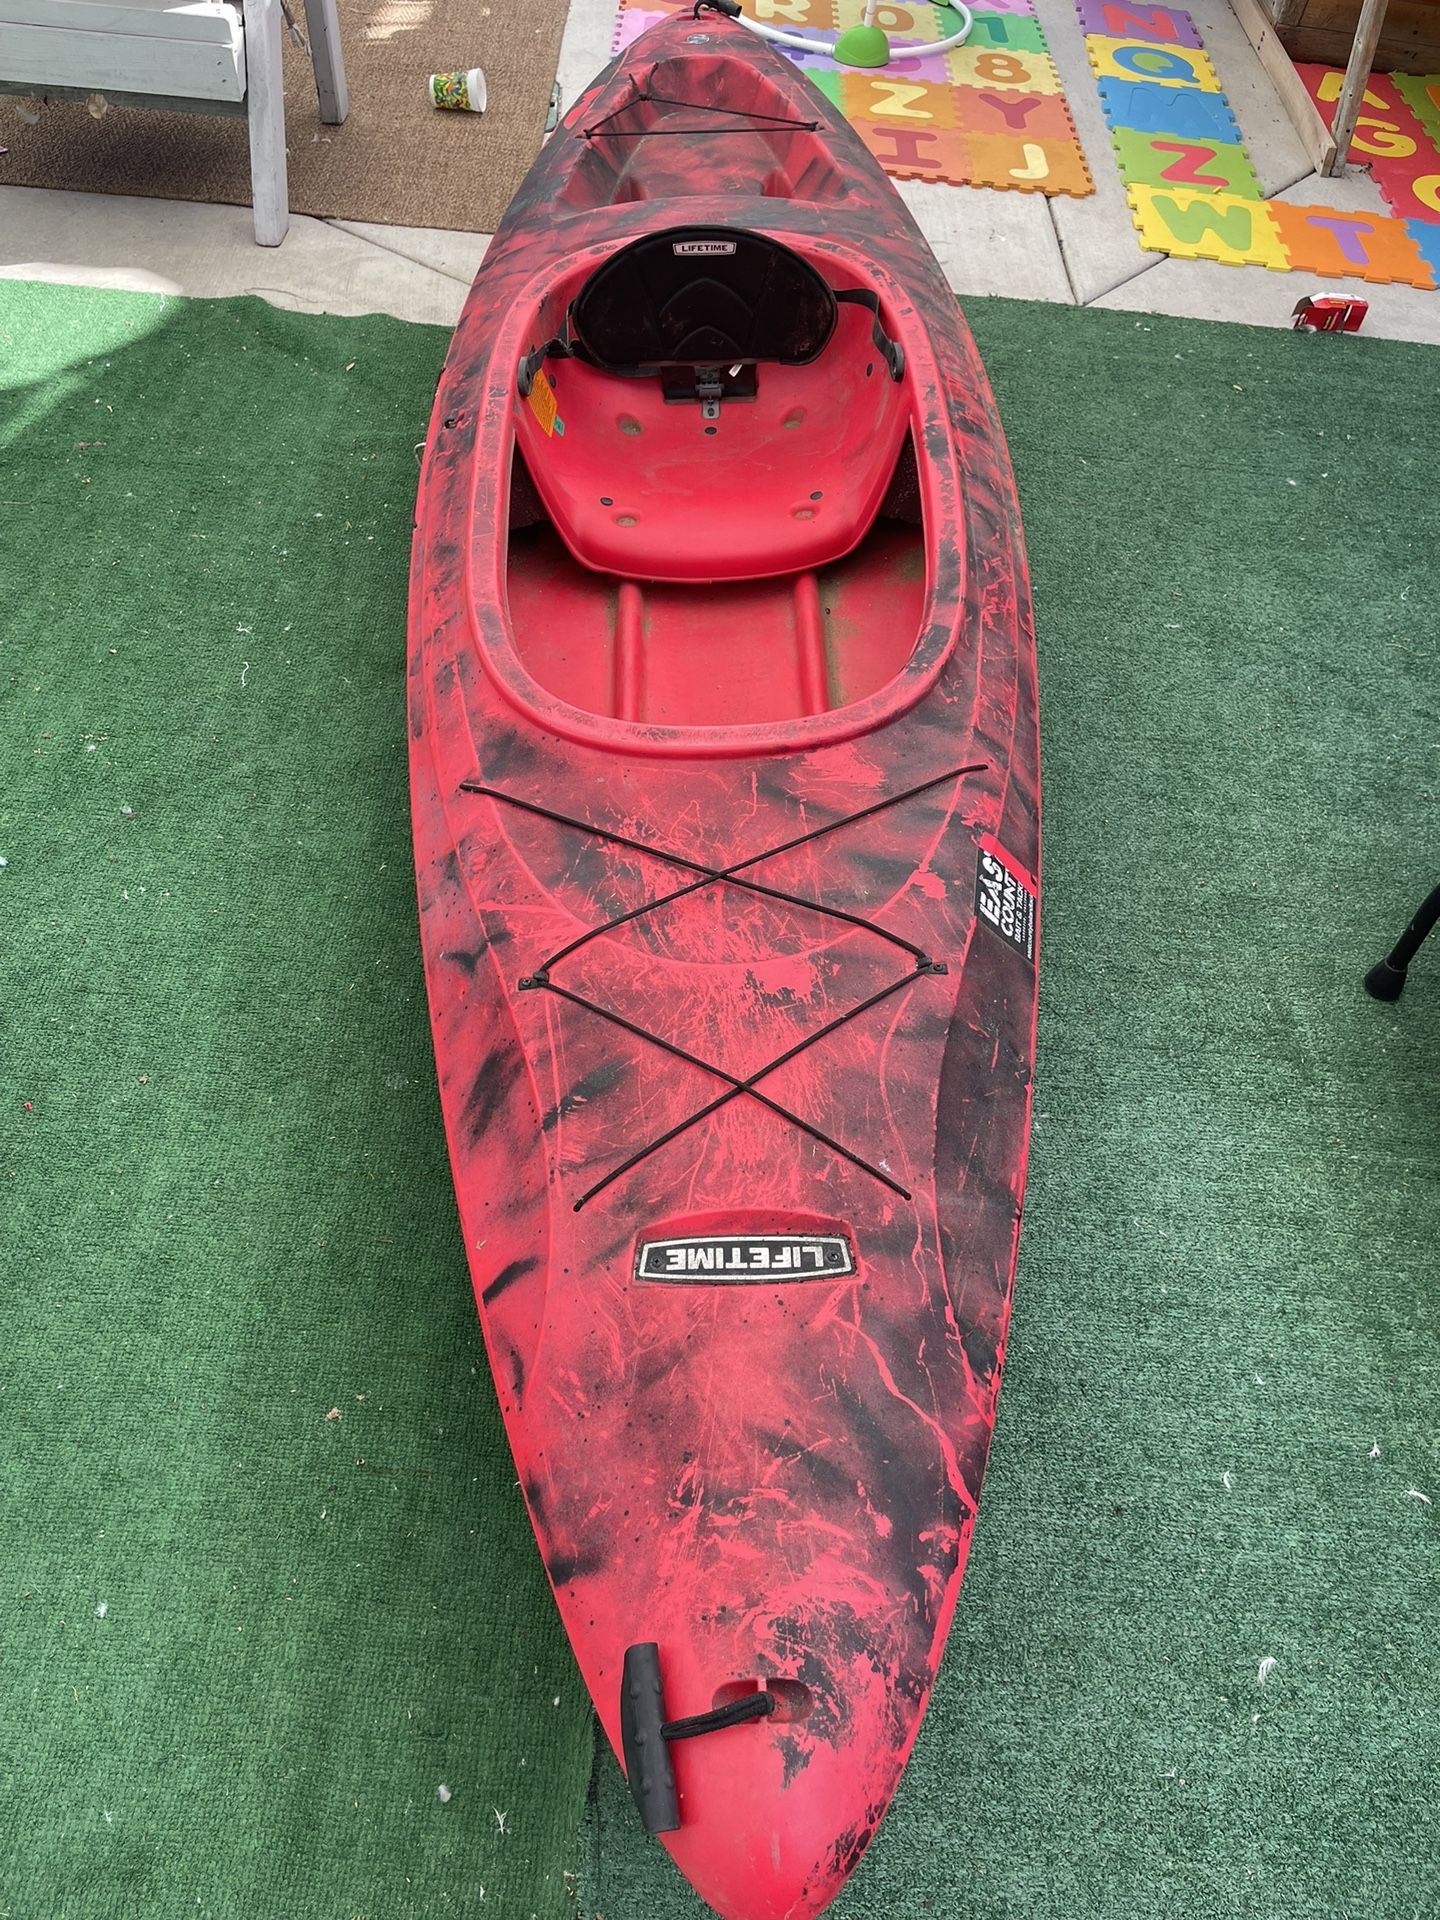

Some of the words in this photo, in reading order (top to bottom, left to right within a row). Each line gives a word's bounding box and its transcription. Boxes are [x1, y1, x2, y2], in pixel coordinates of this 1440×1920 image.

[1102, 4, 1178, 40] N
[974, 53, 1031, 84] 8
[1112, 46, 1200, 83] Q
[869, 81, 934, 119] Z
[978, 93, 1042, 129] Y
[1009, 143, 1050, 180] J
[1151, 195, 1252, 251] W
[1306, 215, 1376, 265] T
[681, 244, 728, 252] LIFETIME
[1001, 867, 1017, 937] COUNT
[1014, 918, 1022, 943] BAIT
[666, 1246, 825, 1271] LIFETIME
